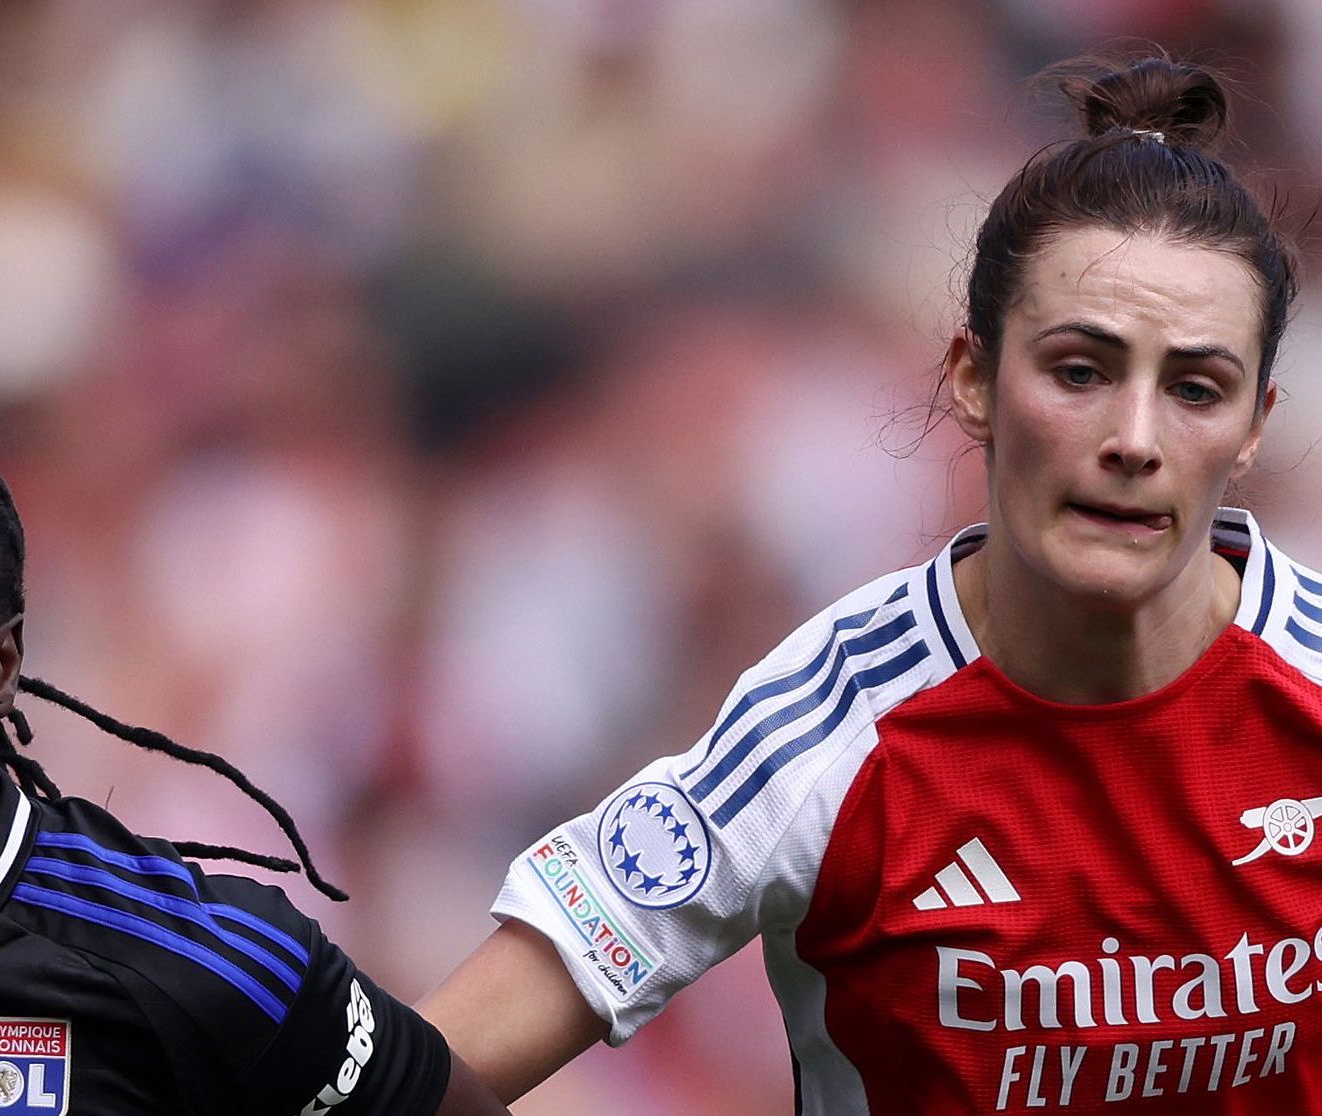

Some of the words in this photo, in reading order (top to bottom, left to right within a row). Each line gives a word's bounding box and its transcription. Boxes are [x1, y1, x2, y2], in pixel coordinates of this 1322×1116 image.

[551, 835, 578, 867] UEFA
[583, 949, 599, 963] for
[599, 962, 628, 996] children
[995, 1044, 1088, 1111] FLY
[1105, 1021, 1296, 1103] BETTER
